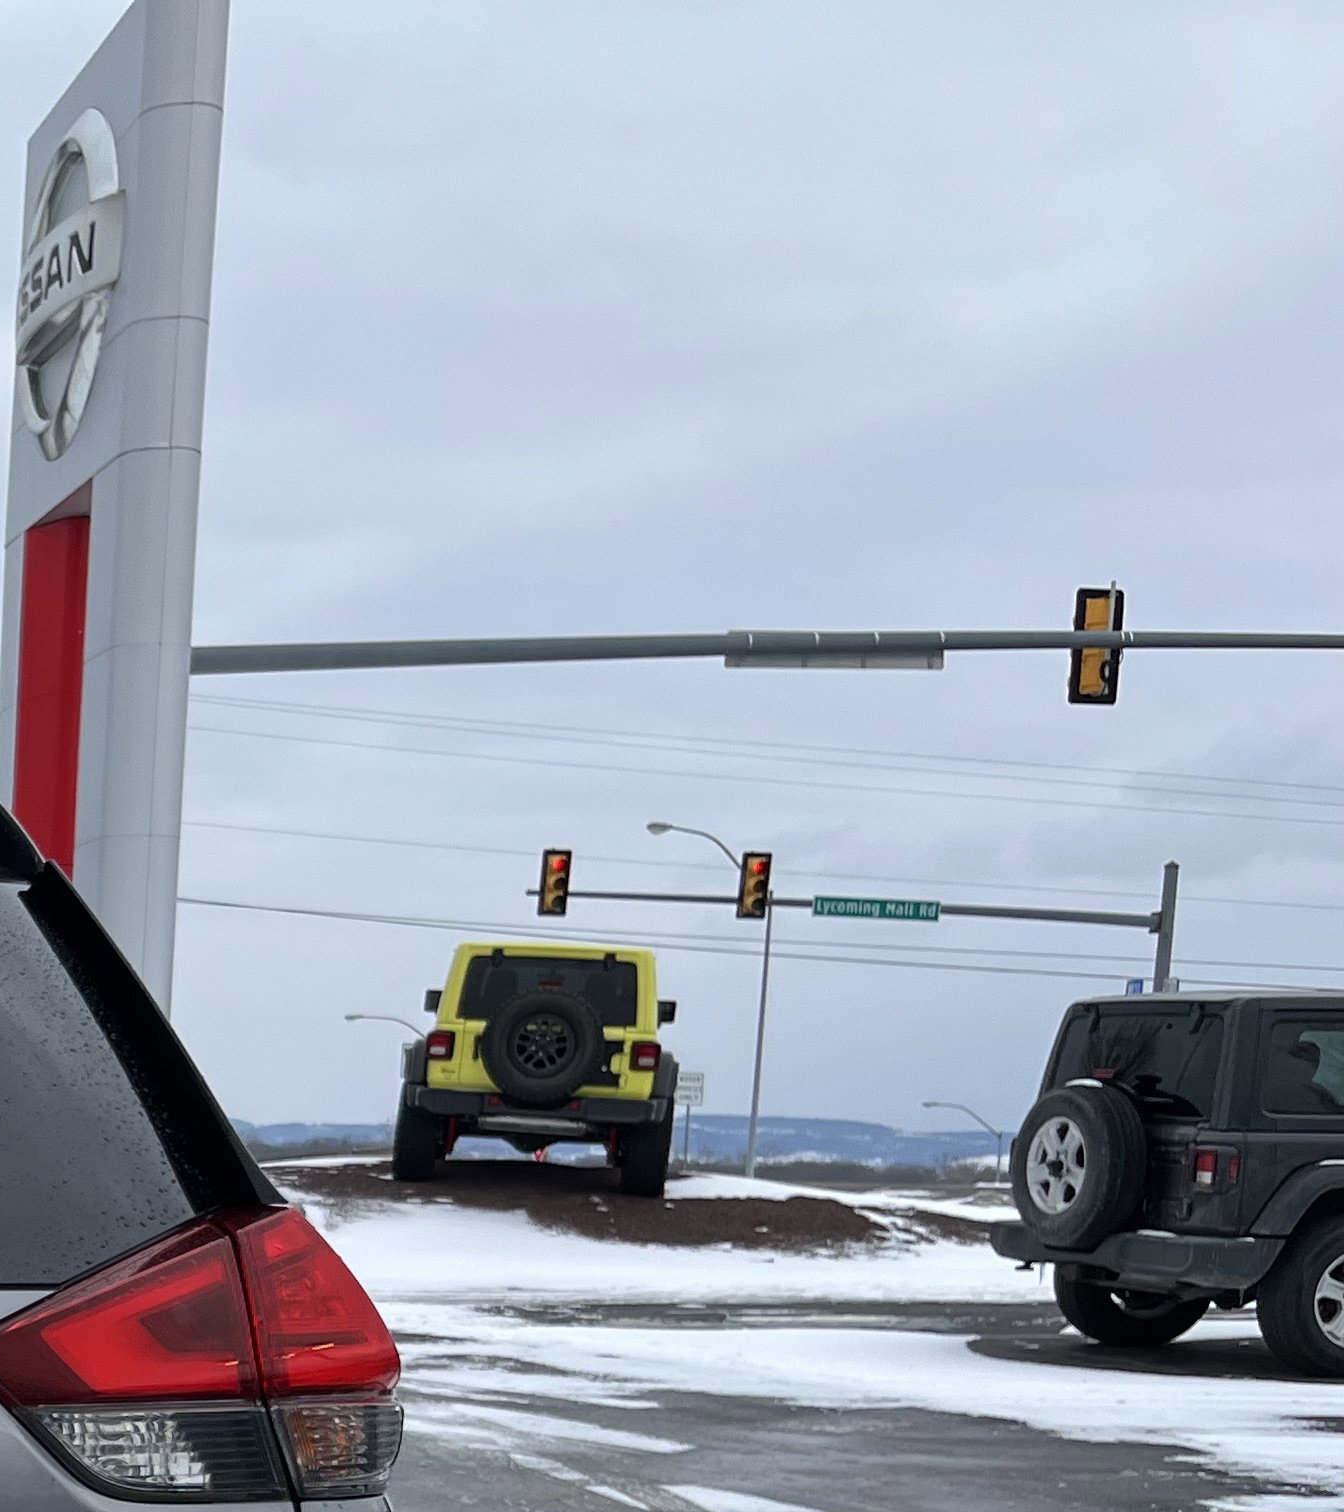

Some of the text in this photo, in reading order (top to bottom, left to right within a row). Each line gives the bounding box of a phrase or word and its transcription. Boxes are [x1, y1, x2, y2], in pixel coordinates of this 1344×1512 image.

[19, 220, 97, 325] SSAN
[816, 899, 937, 918] Lycoming Mall Rd
